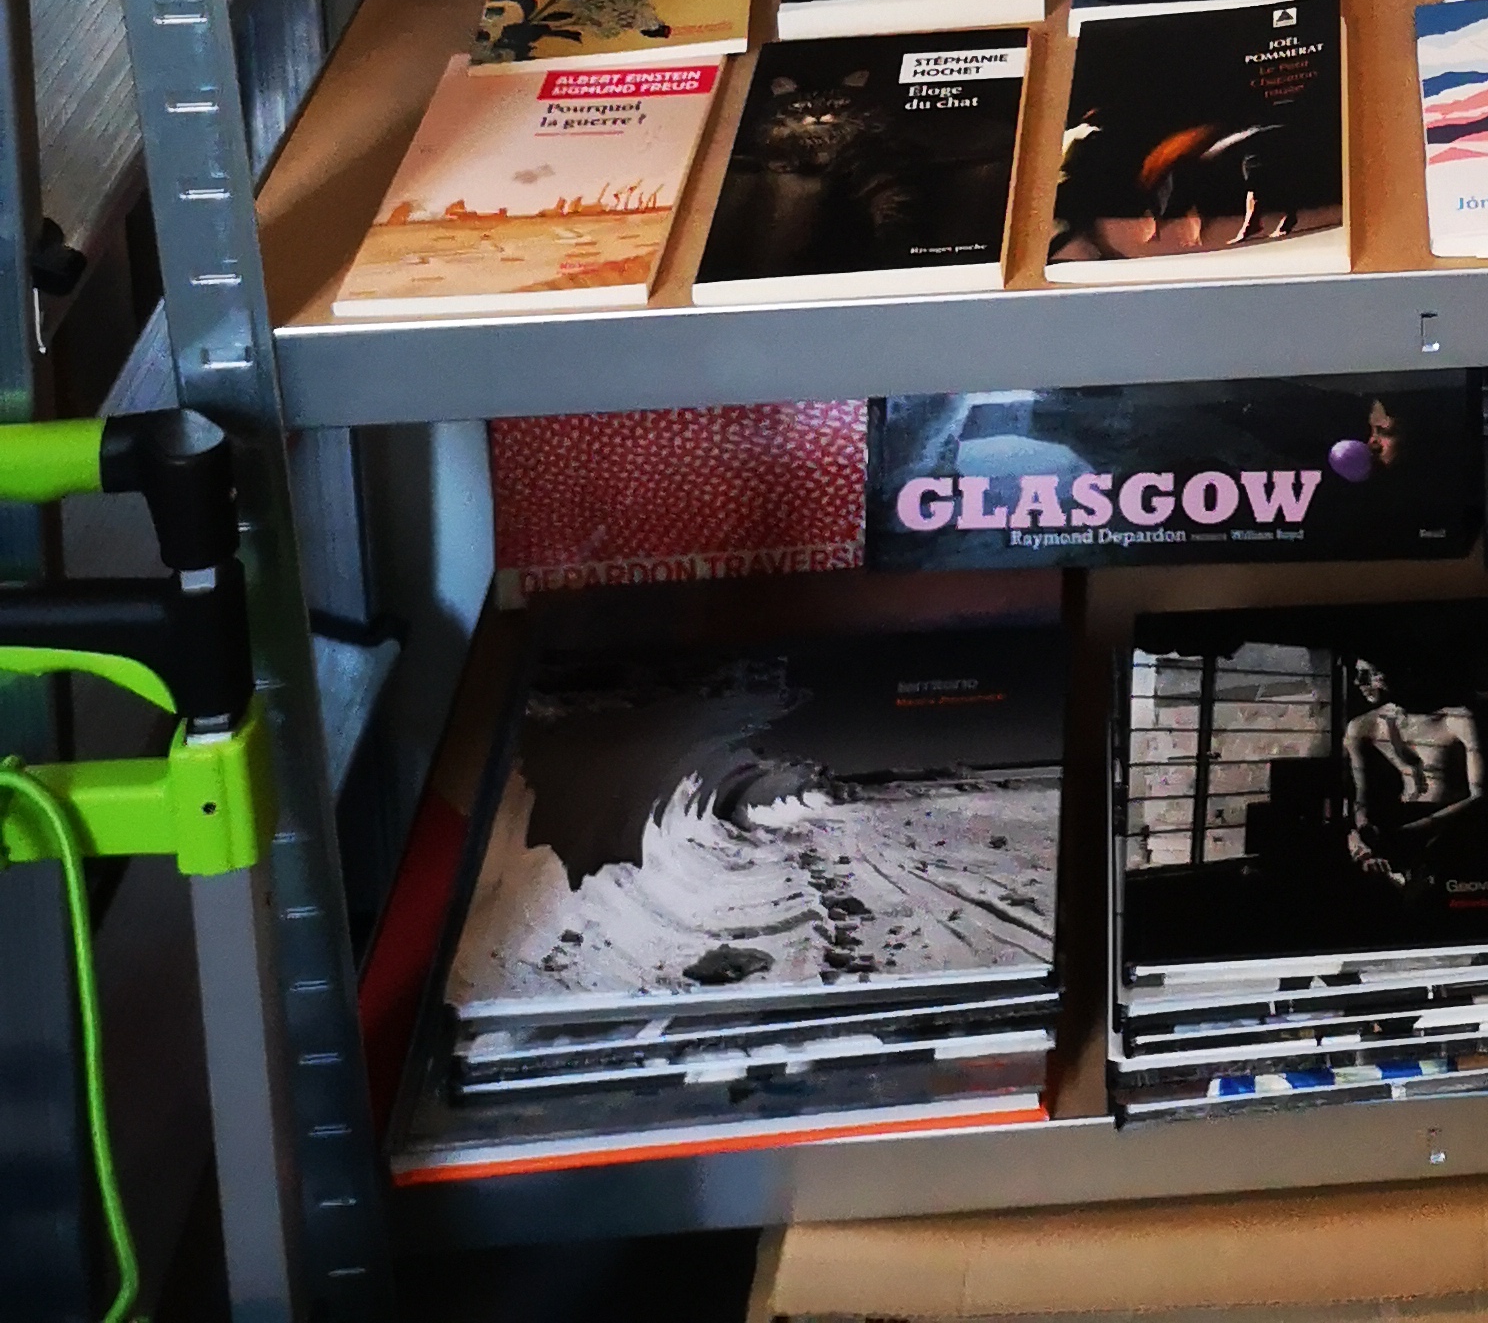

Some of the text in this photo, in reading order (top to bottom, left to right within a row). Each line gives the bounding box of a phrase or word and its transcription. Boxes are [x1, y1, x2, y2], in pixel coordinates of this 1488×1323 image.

[1244, 42, 1325, 65] POMMERAT
[555, 70, 702, 86] ALBERT EINSTEIN
[912, 65, 984, 78] HOCHET
[639, 81, 700, 93] FREUD
[546, 100, 643, 116] Pourquoi
[904, 96, 980, 111] du chat
[539, 116, 633, 130] la guerre
[896, 470, 1323, 531] GLASGOW
[1009, 526, 1188, 550] Raymond Depardon
